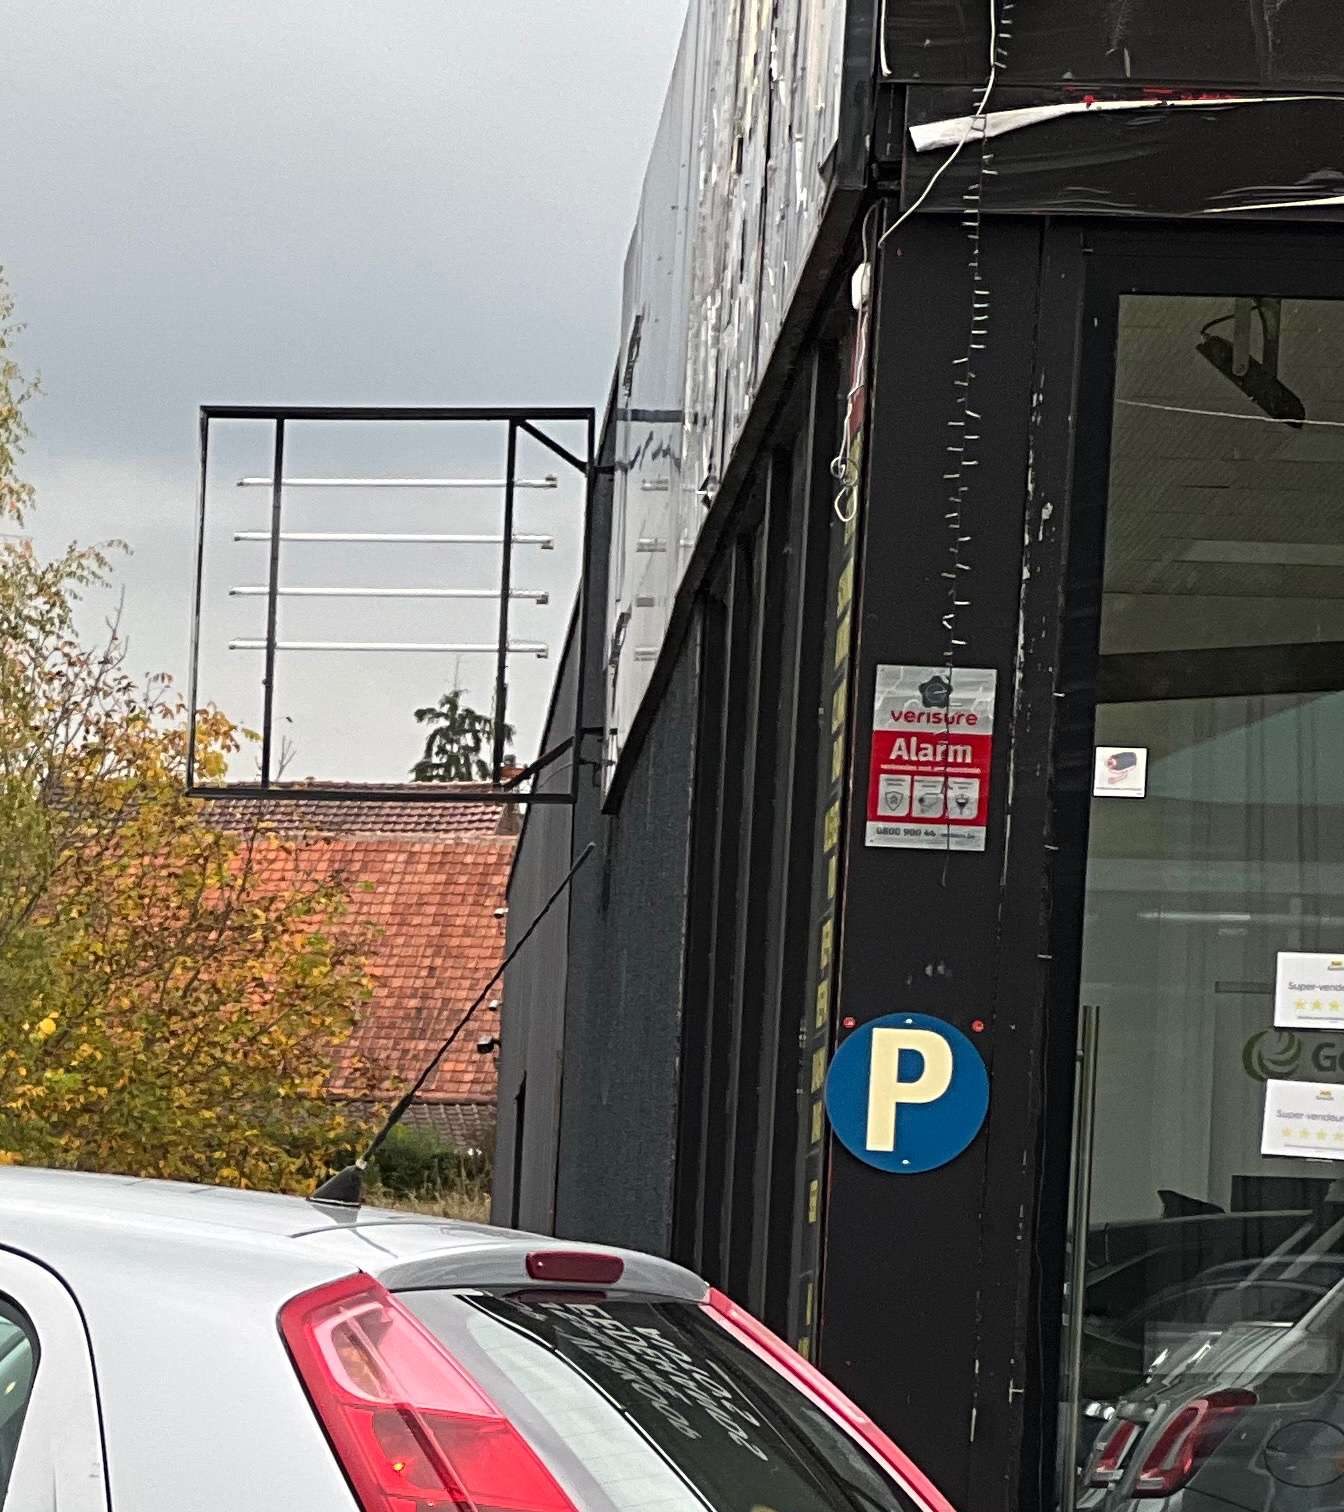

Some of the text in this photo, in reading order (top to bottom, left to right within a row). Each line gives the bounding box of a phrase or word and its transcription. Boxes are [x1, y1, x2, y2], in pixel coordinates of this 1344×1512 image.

[890, 710, 978, 725] verisure
[889, 736, 972, 763] Alarm
[865, 1027, 953, 1153] P
